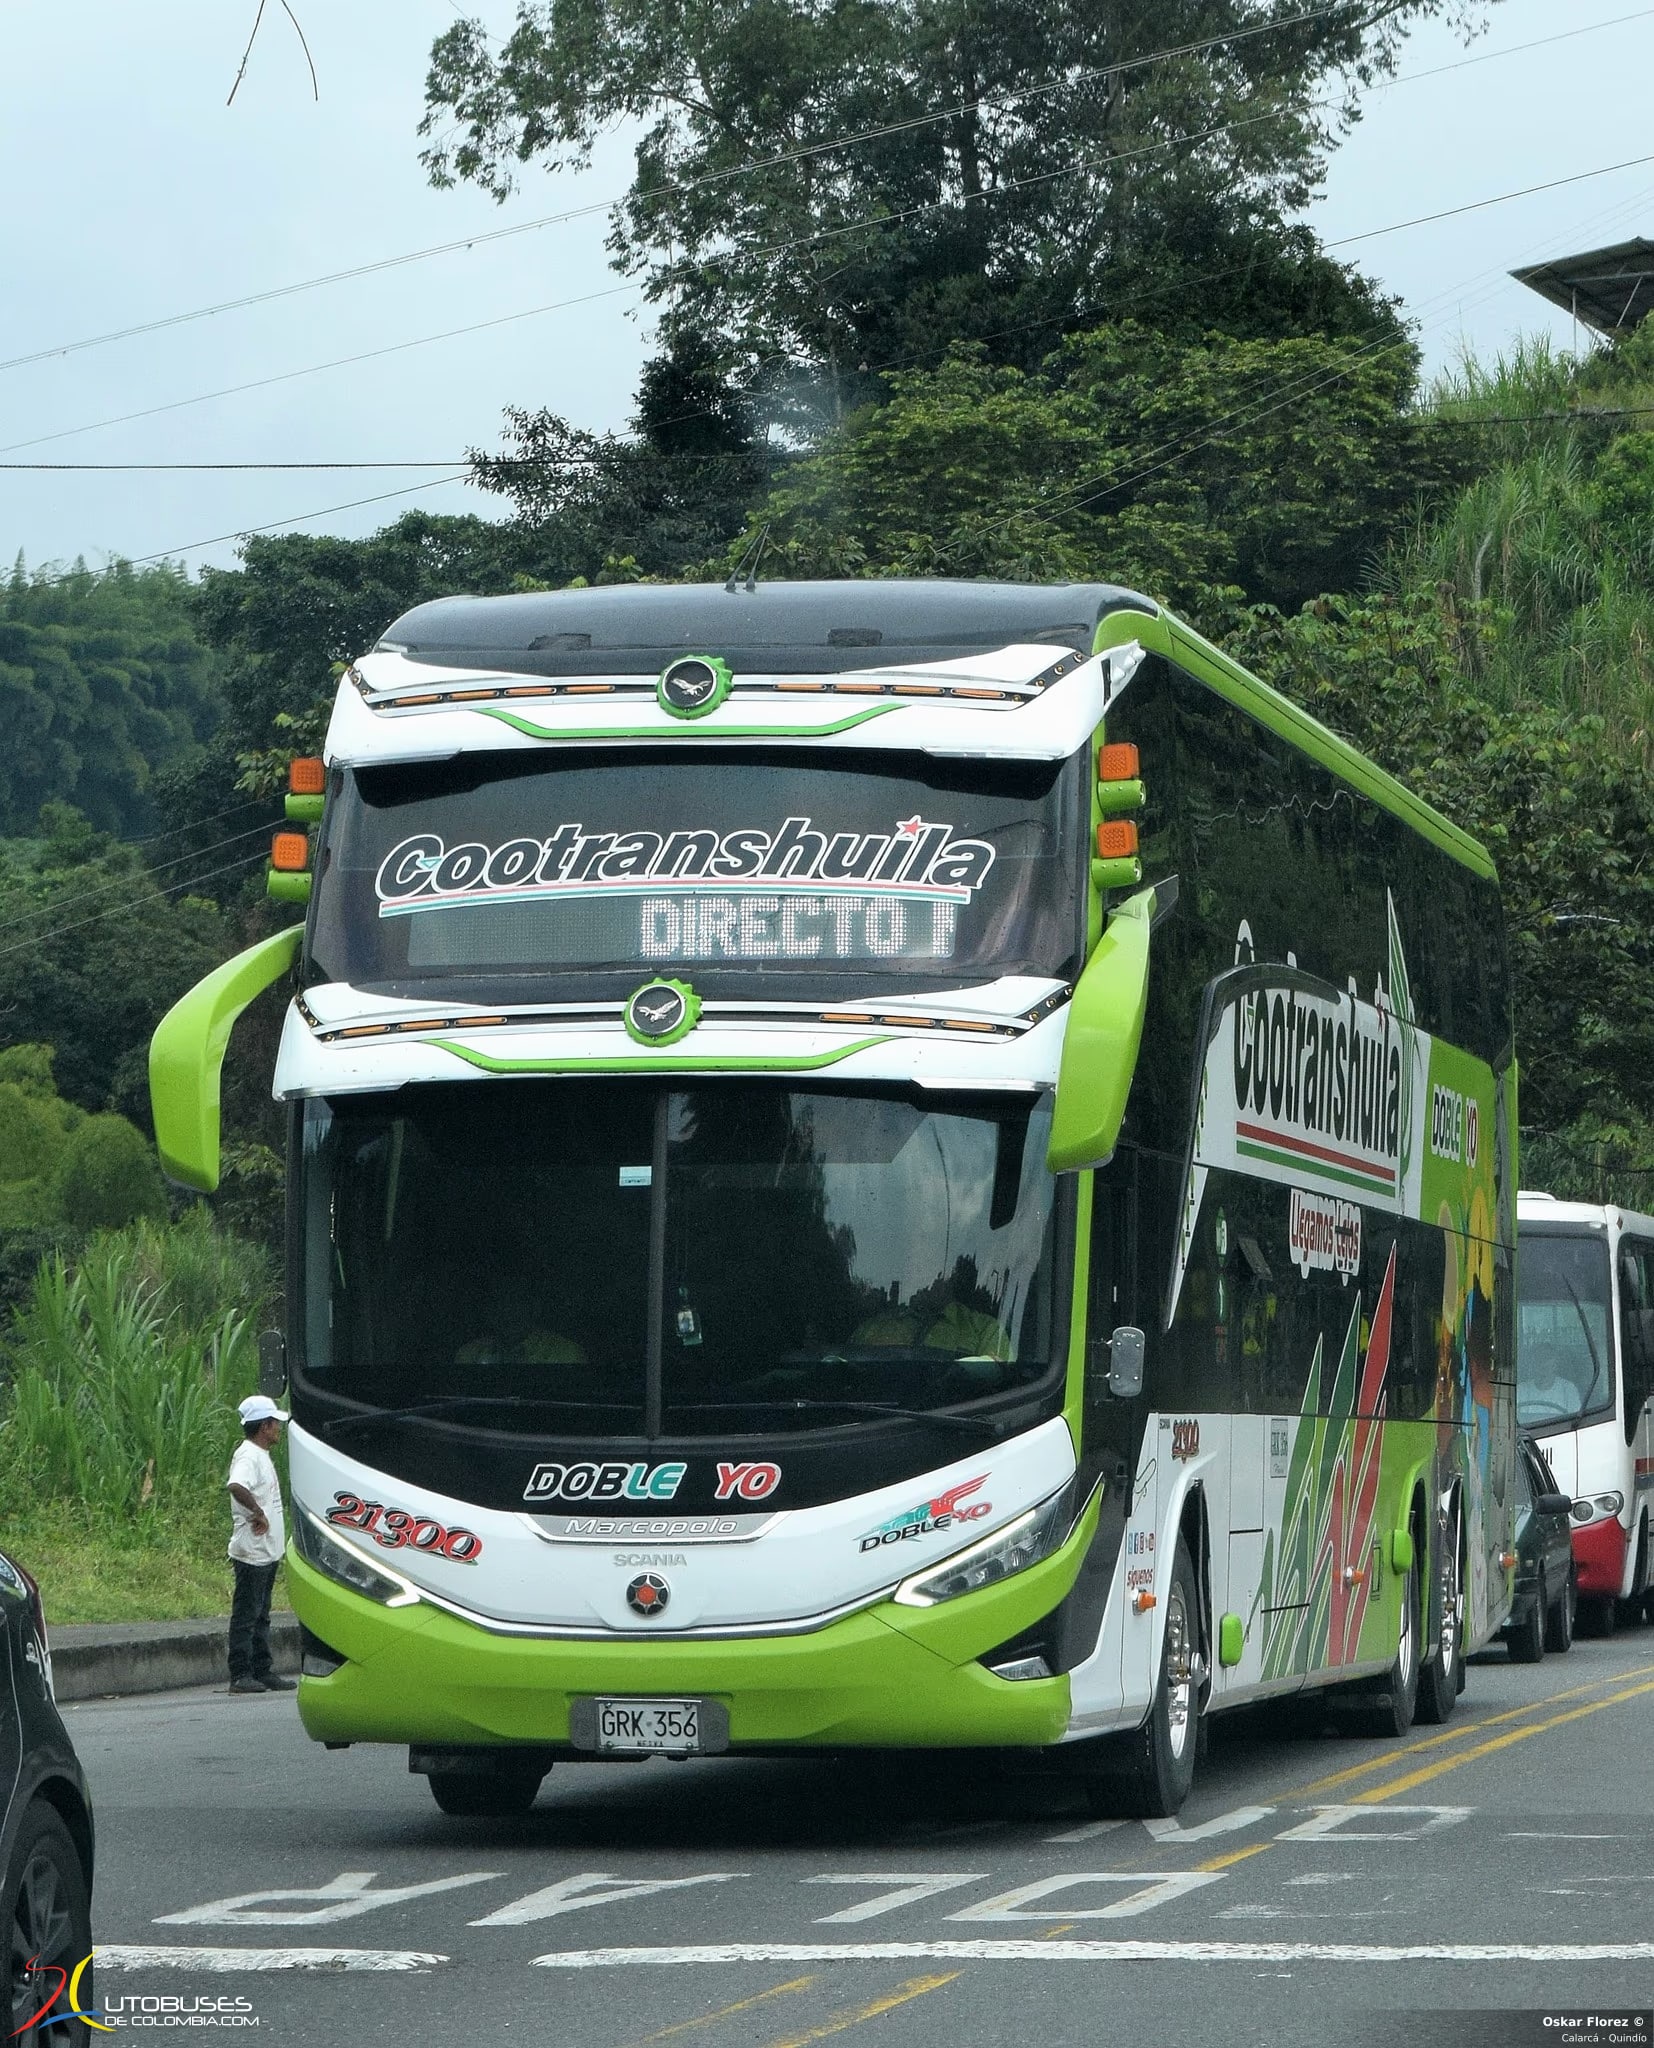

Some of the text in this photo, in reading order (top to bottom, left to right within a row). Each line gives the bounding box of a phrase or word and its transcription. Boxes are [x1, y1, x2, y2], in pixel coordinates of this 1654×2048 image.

[375, 816, 996, 900] Cootranshuila
[641, 897, 907, 957] DIRECTO
[1234, 930, 1401, 1159] Cootranshuila
[1432, 1086, 1478, 1167] DOBLE YO
[1291, 1189, 1335, 1265] Llegamos
[524, 1463, 781, 1499] DOBLE YO
[325, 1491, 483, 1565] 21300
[565, 1518, 737, 1537] Marcopolo
[859, 1501, 992, 1553] DOBLE YO
[612, 1553, 687, 1567] SCANIA
[602, 1710, 697, 1737] GRK 356
